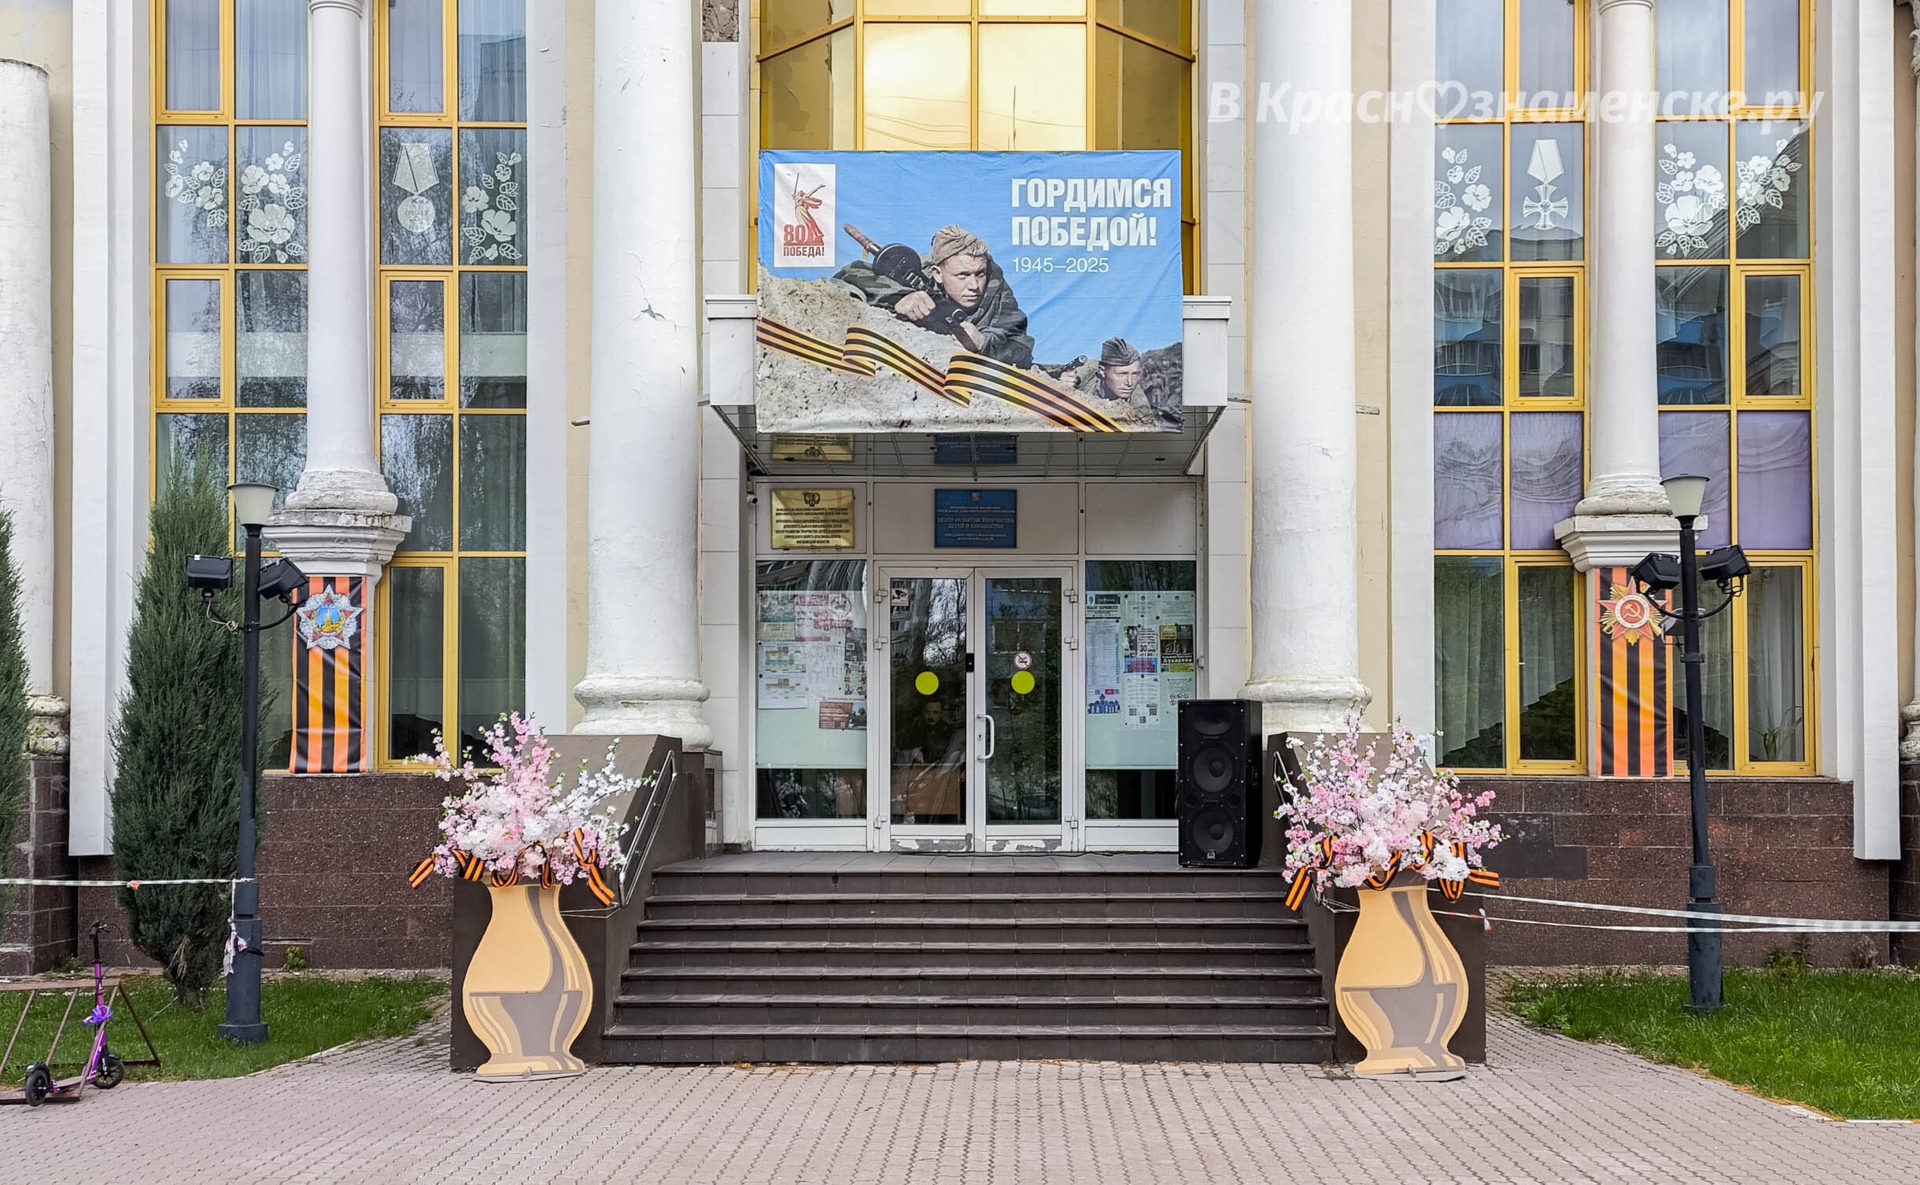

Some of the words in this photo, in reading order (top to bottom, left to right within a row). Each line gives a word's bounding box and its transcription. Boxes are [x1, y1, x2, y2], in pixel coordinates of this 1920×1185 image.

[1011, 178, 1172, 212] ГОРДИМСЯ
[783, 224, 806, 243] 80
[1011, 212, 1157, 251] ПОБЕДОЙ!
[783, 246, 825, 258] ПОБЕДА!
